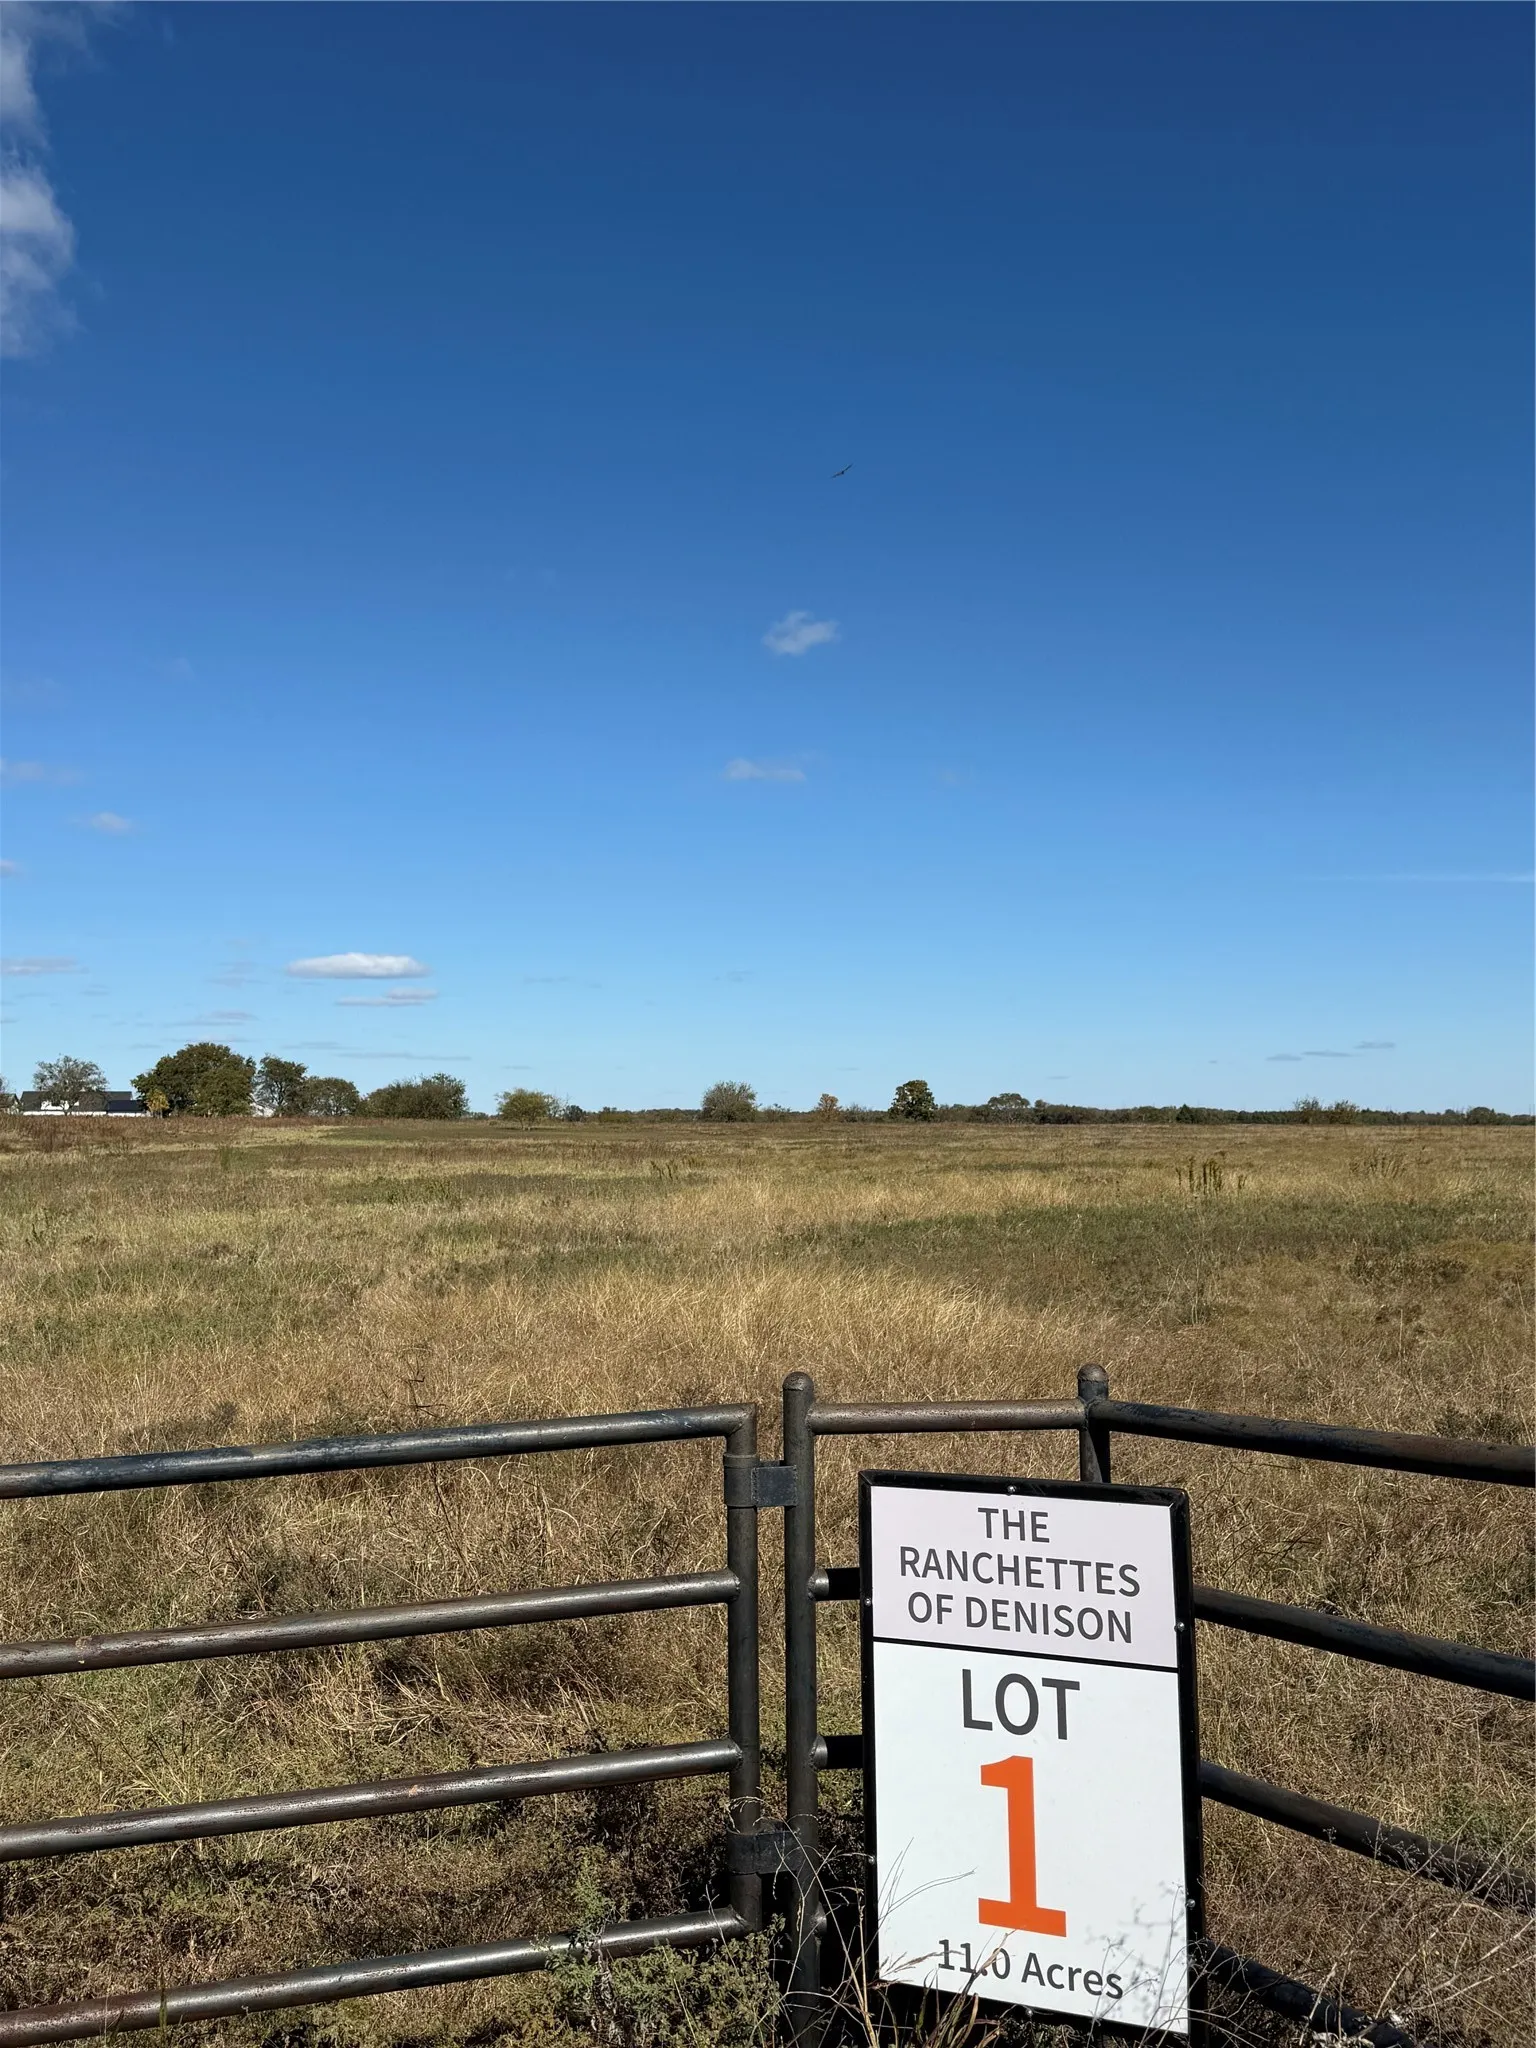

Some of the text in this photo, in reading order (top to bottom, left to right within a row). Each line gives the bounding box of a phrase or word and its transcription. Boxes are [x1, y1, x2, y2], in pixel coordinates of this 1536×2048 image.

[977, 1507, 1050, 1543] THE
[899, 1546, 1140, 1597] RANCHETTES
[908, 1591, 1132, 1643] OF DENISON
[962, 1668, 1080, 1740] LOT
[978, 1755, 1066, 1937] 1
[1021, 1952, 1124, 1999] Acres
